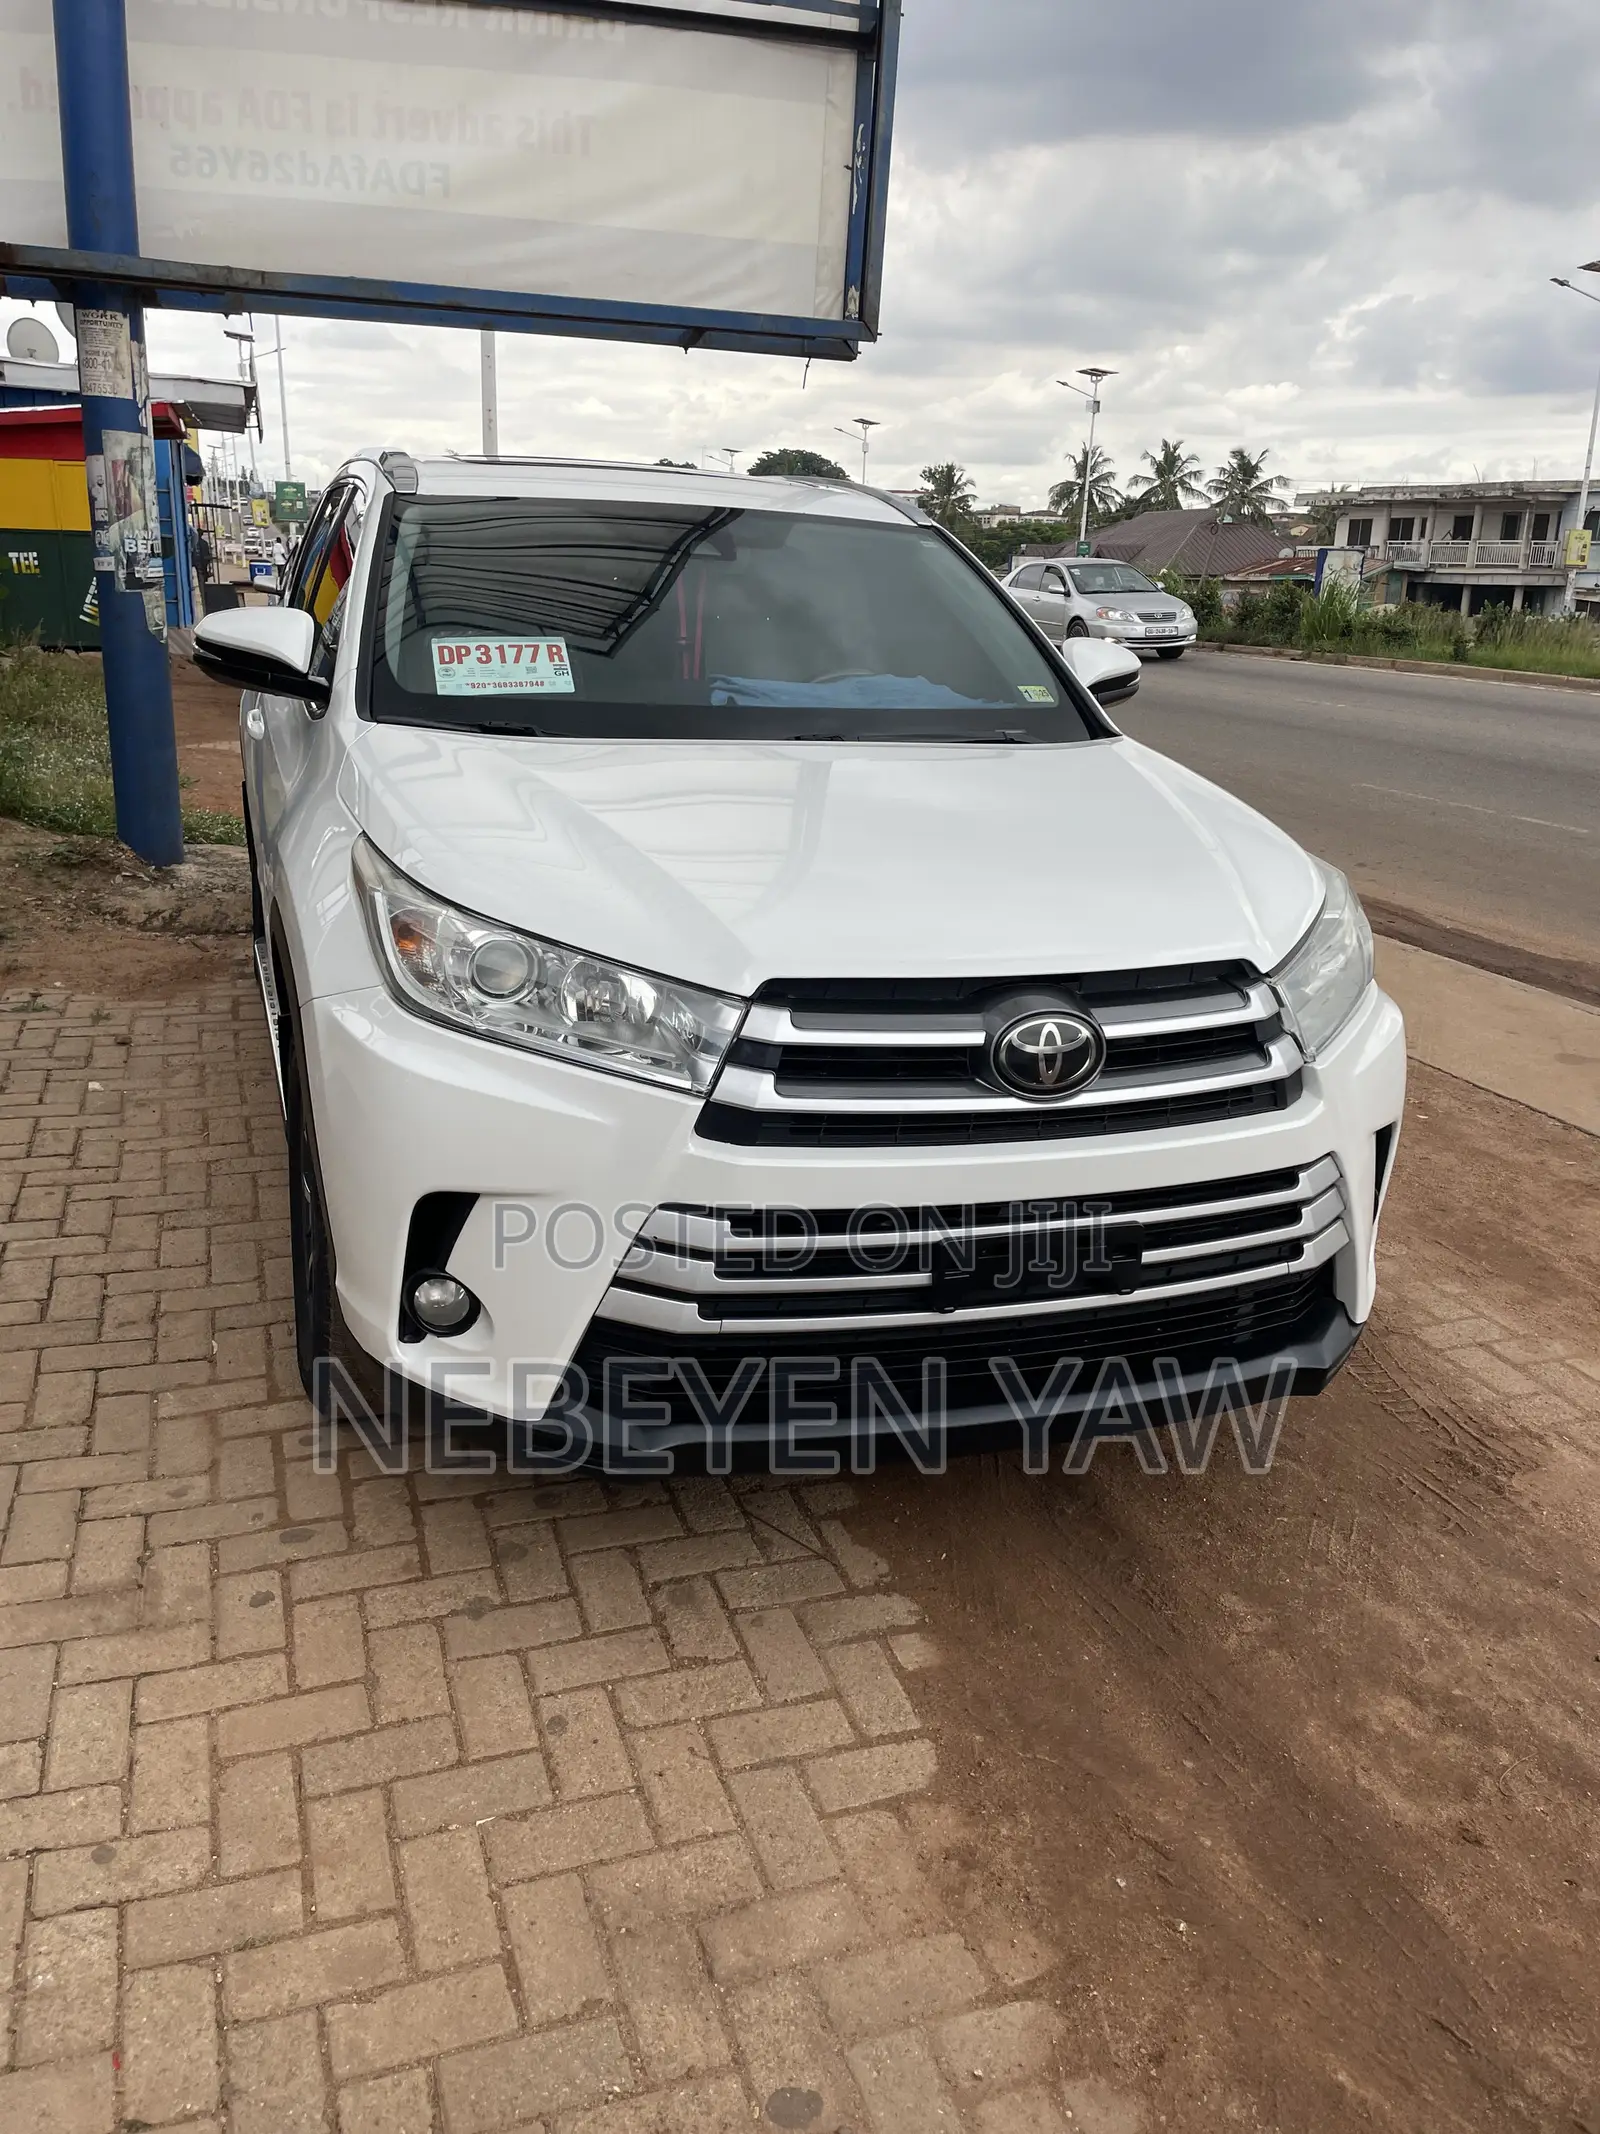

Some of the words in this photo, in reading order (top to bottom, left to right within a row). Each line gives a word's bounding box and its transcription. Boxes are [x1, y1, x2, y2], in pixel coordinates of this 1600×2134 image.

[81, 311, 118, 320] WORK
[437, 645, 471, 665] DP
[475, 644, 540, 664] 3177
[546, 644, 565, 663] R
